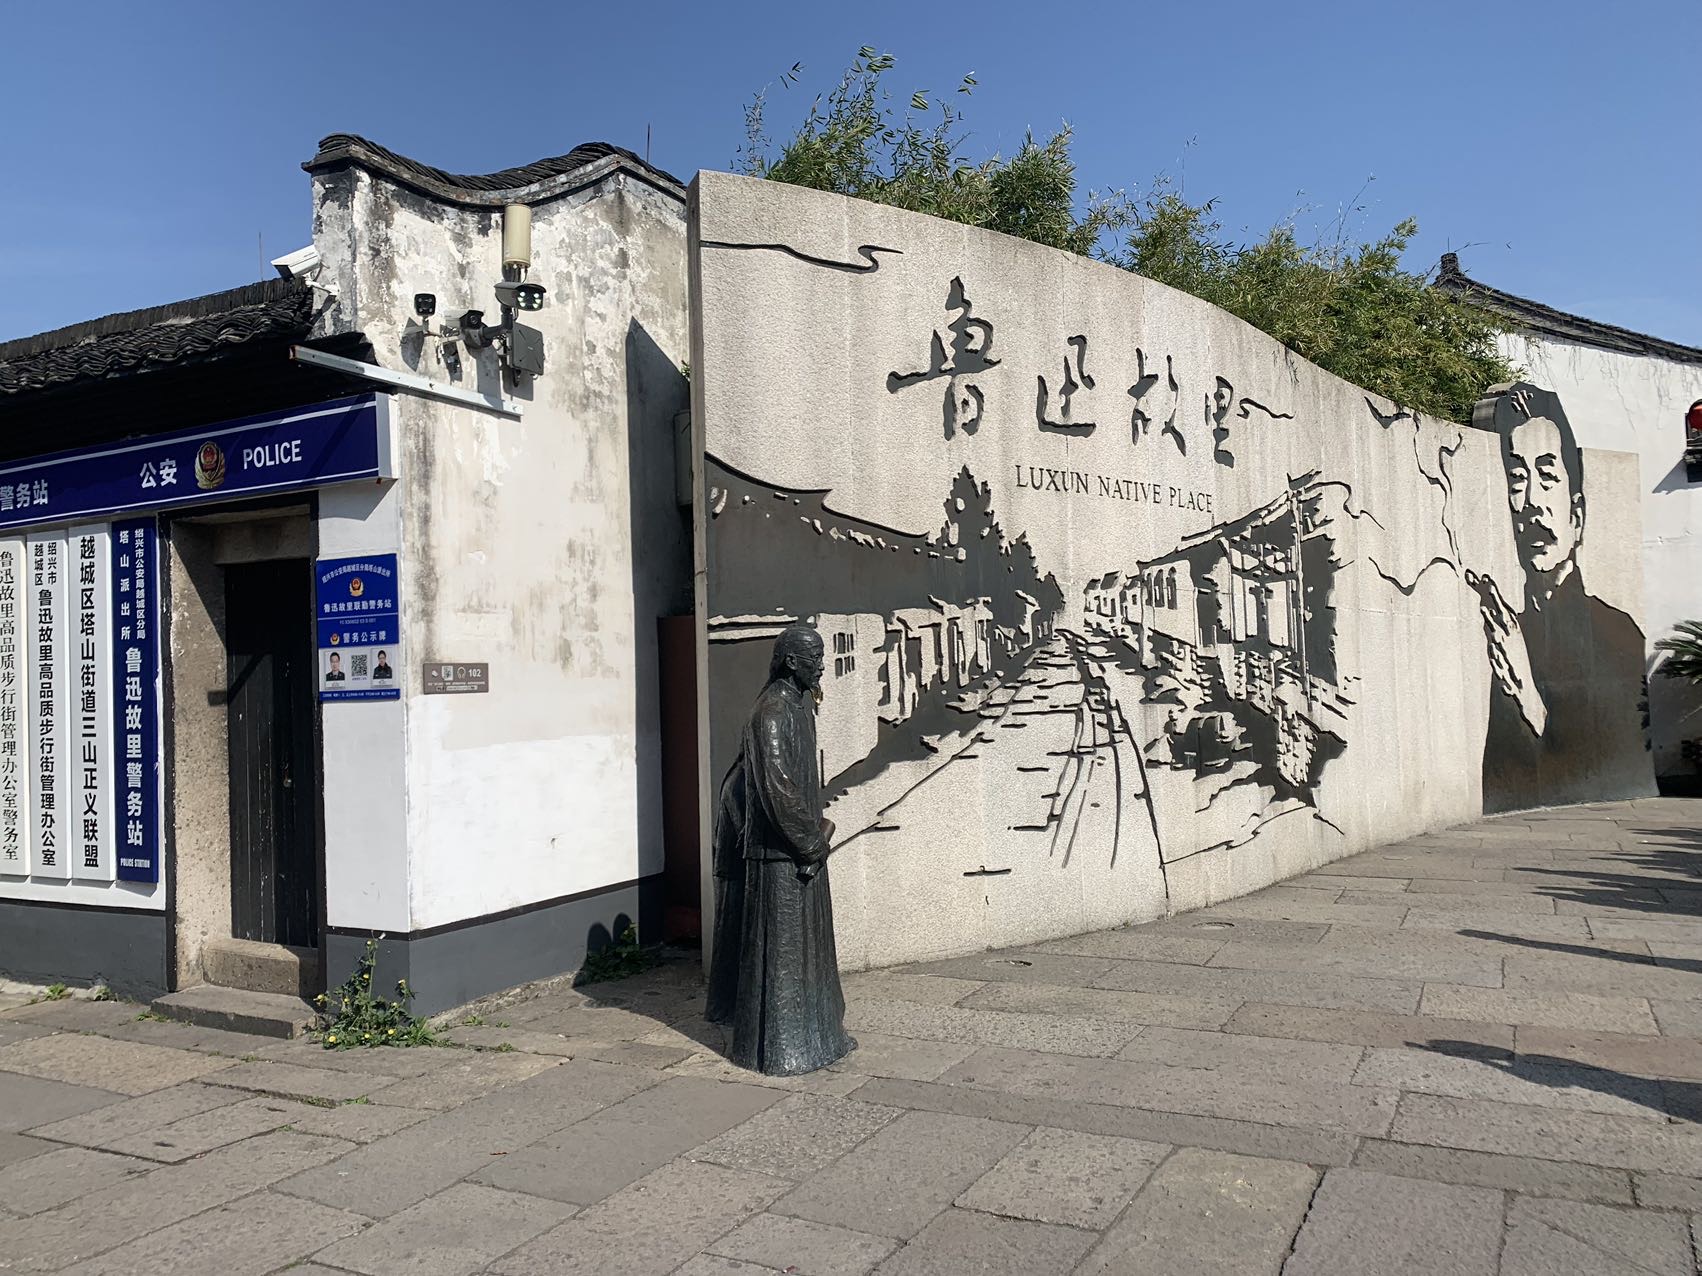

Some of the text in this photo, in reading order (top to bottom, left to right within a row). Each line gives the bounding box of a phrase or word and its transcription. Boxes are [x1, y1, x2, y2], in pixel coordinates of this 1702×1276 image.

[887, 276, 1235, 468] 鲁迅故里
[139, 458, 177, 489] 公安
[243, 440, 301, 470] POLICE
[0, 479, 48, 511] 警务站
[1015, 464, 1213, 514] LUXUN NATIVE PLACE
[34, 543, 44, 586] 越城区
[47, 541, 57, 586] 绍兴市
[119, 530, 131, 641] 塔山派出所
[134, 528, 146, 640] 绍兴市公安局越城区分局
[343, 630, 386, 644] 警务公示牌
[468, 668, 481, 678] 102
[80, 535, 99, 868] 越城区塔山街道三山正义联盟
[38, 589, 56, 866] 鲁迅故里高品质步行街管理办公室
[125, 647, 144, 846] 鲁迅故里警务站
